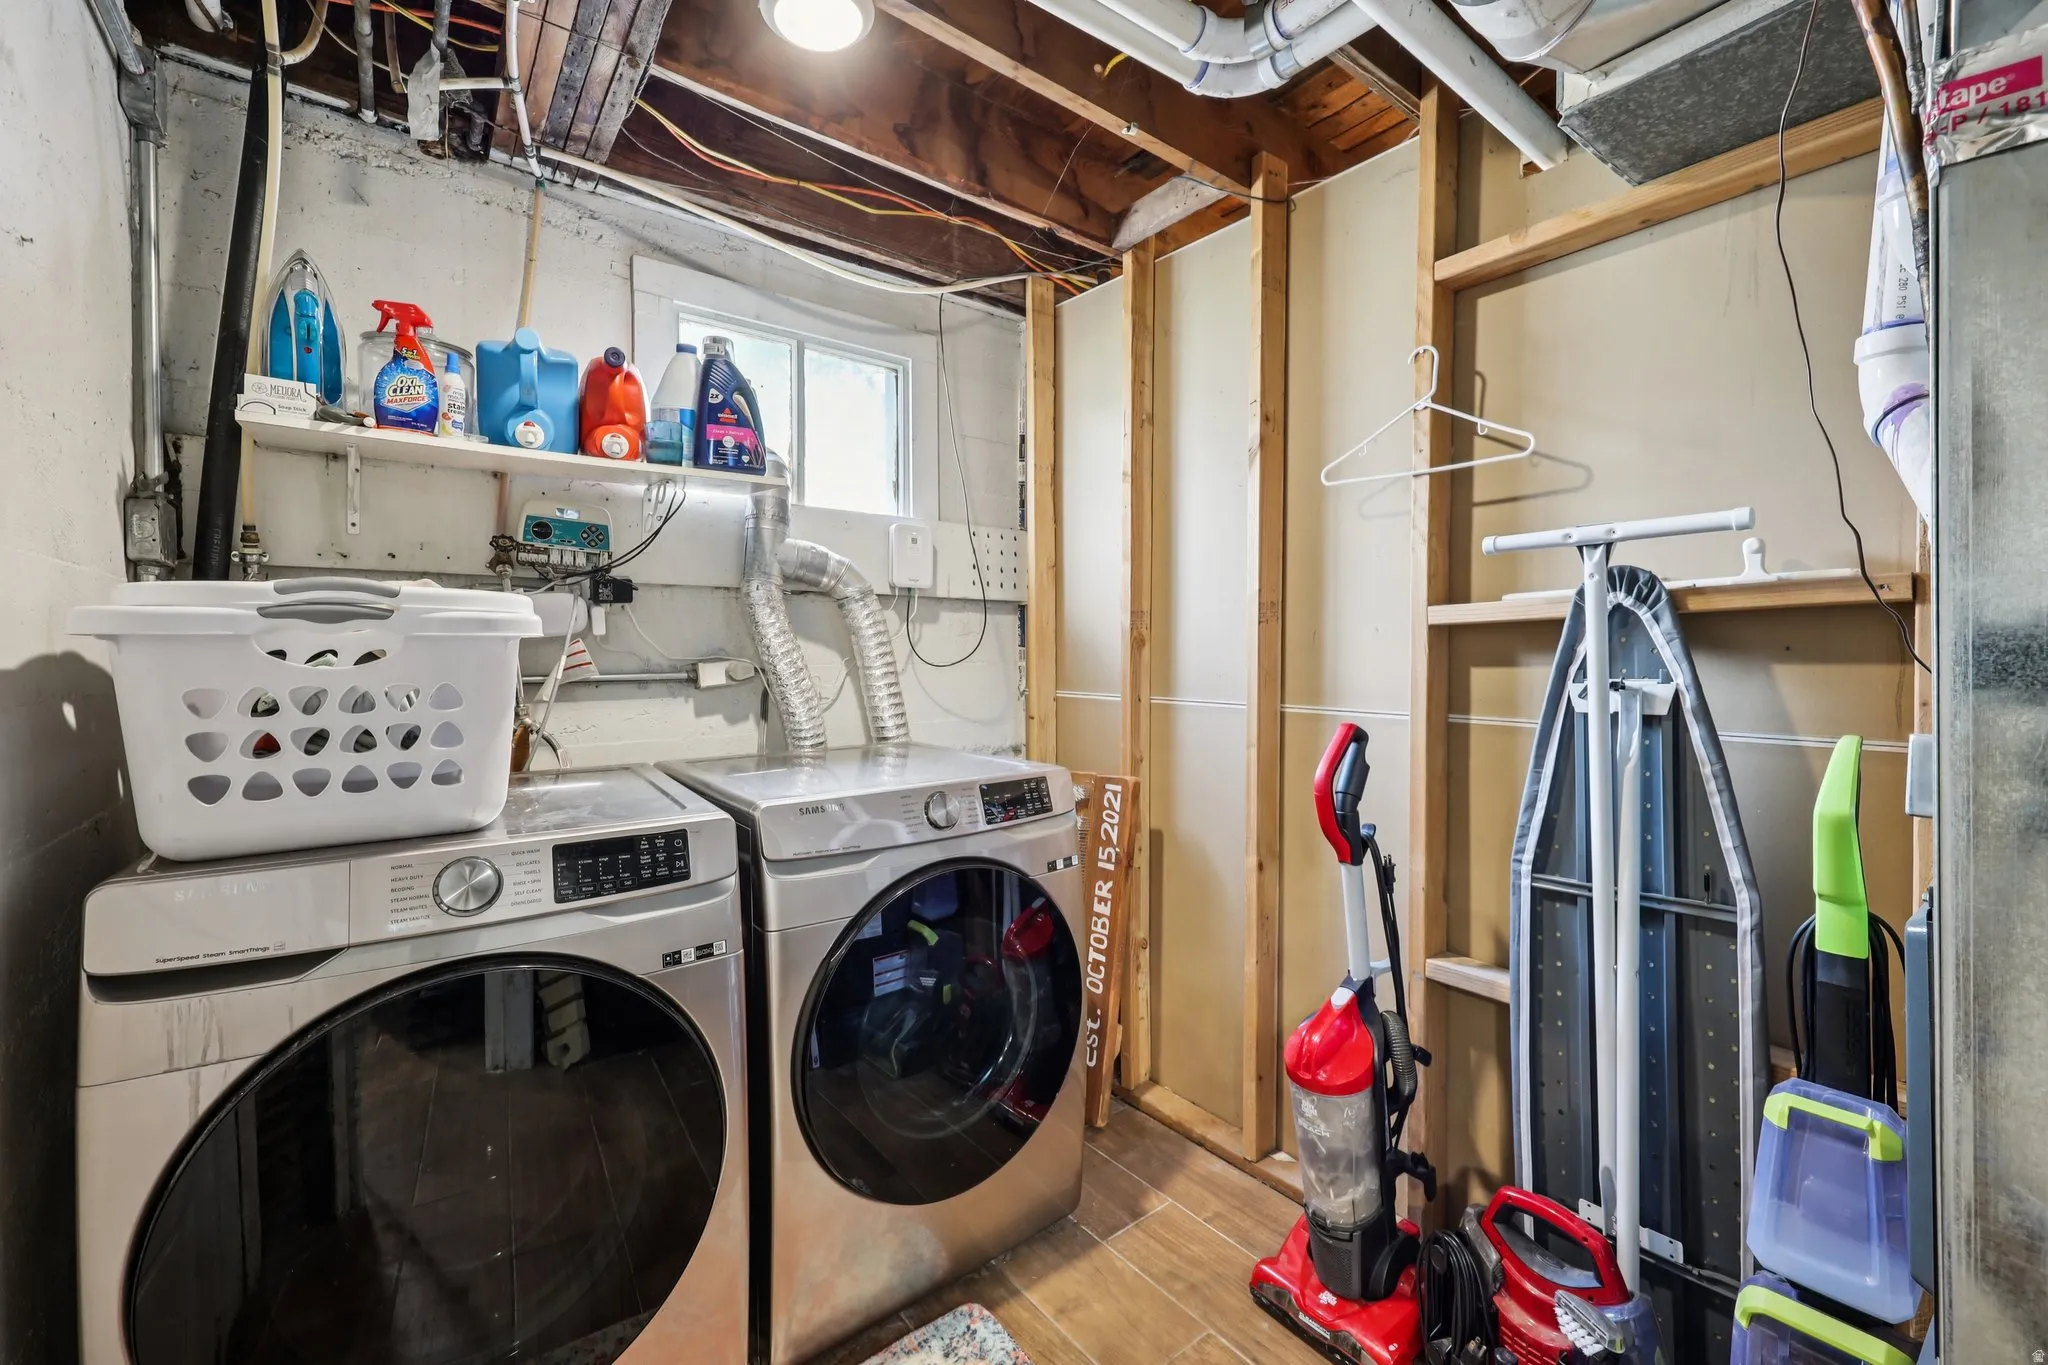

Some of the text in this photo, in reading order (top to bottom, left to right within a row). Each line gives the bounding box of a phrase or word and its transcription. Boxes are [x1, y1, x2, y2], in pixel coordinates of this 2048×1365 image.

[388, 384, 424, 396] CLEAN
[397, 376, 417, 388] OXI
[266, 383, 307, 402] MELIORA
[1086, 880, 1114, 995] OCTOBER
[155, 954, 200, 964] SuperSpeed
[202, 951, 226, 959] Steam
[228, 944, 270, 956] SmartThings
